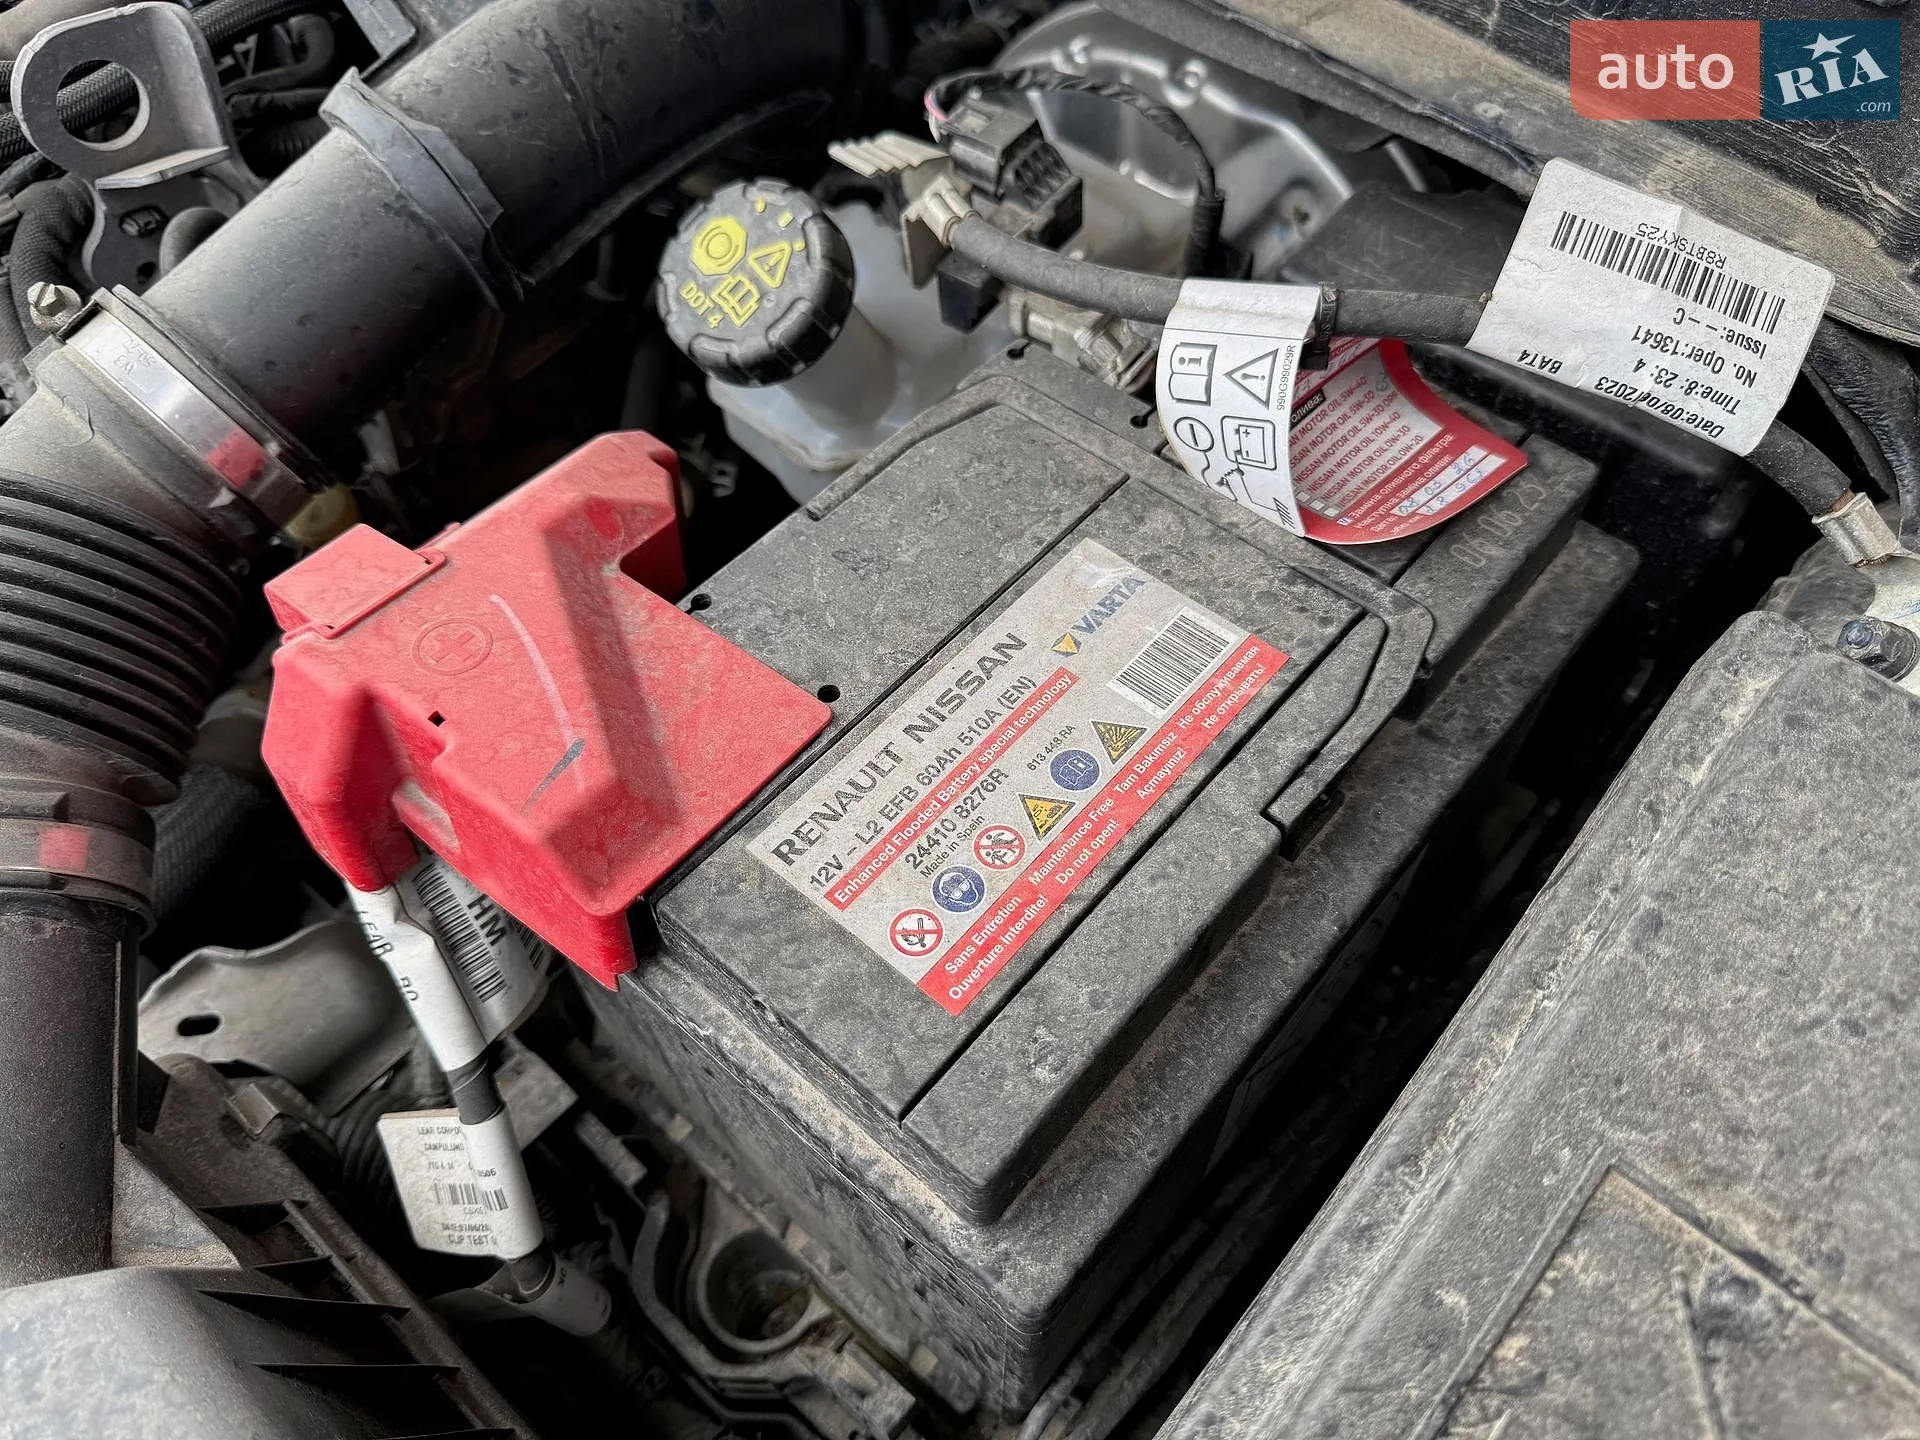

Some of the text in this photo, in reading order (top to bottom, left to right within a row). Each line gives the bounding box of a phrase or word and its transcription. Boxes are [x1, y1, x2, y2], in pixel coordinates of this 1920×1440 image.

[1634, 220, 1727, 268] R8BTSKY25
[680, 281, 724, 329] DOT 4
[1276, 344, 1296, 411] 990G99029R
[1516, 347, 1562, 375] BAT4
[1630, 322, 1757, 387] No. Oper:13641
[1632, 356, 1741, 415] Time:8: 23: 4
[1285, 444, 1311, 468] SSAN
[1309, 422, 1338, 448] MOTOR
[1335, 410, 1351, 425] OIL
[1348, 389, 1376, 415] 5W-30
[1292, 456, 1324, 485] NISSAN
[1319, 434, 1349, 461] MOTOR
[1346, 423, 1362, 438] OIL
[1358, 403, 1386, 428] 5W-30
[1296, 409, 1328, 437] MOTOR
[1325, 396, 1342, 412] OIL
[1306, 465, 1337, 494] NISSAN
[1333, 444, 1362, 471] MOTOR
[1358, 433, 1375, 449] OIL
[1320, 473, 1352, 502] NISSAN
[1349, 453, 1377, 478] MOTOR
[1373, 443, 1388, 457] OIL
[1362, 461, 1390, 487] MOTOR
[1386, 451, 1401, 466] OIL
[1072, 576, 1147, 634] VARTA
[1176, 645, 1259, 730] Не обслуживаемая
[1201, 663, 1266, 729] Не открывать!
[771, 632, 1027, 866] RENAULT NISSAN
[1025, 751, 1047, 772] 613
[1059, 723, 1075, 739] RA
[807, 853, 846, 891] 12V
[856, 816, 884, 845] L2
[878, 782, 920, 823] EFB
[913, 741, 962, 789] 60Ah
[956, 703, 1003, 749] 510A
[995, 672, 1036, 713] (EN)
[834, 670, 1073, 904] Enhanced Flooded Battery special technology
[1113, 769, 1137, 796] Tam
[903, 765, 1009, 870] 24410 8276R
[919, 813, 986, 878] Made in Spain
[1028, 796, 1113, 886] Maintenance Free
[1055, 817, 1119, 885] Do not open!
[944, 893, 1021, 975] Sans Entretien
[948, 894, 1049, 1001] Ouverture Interdite!
